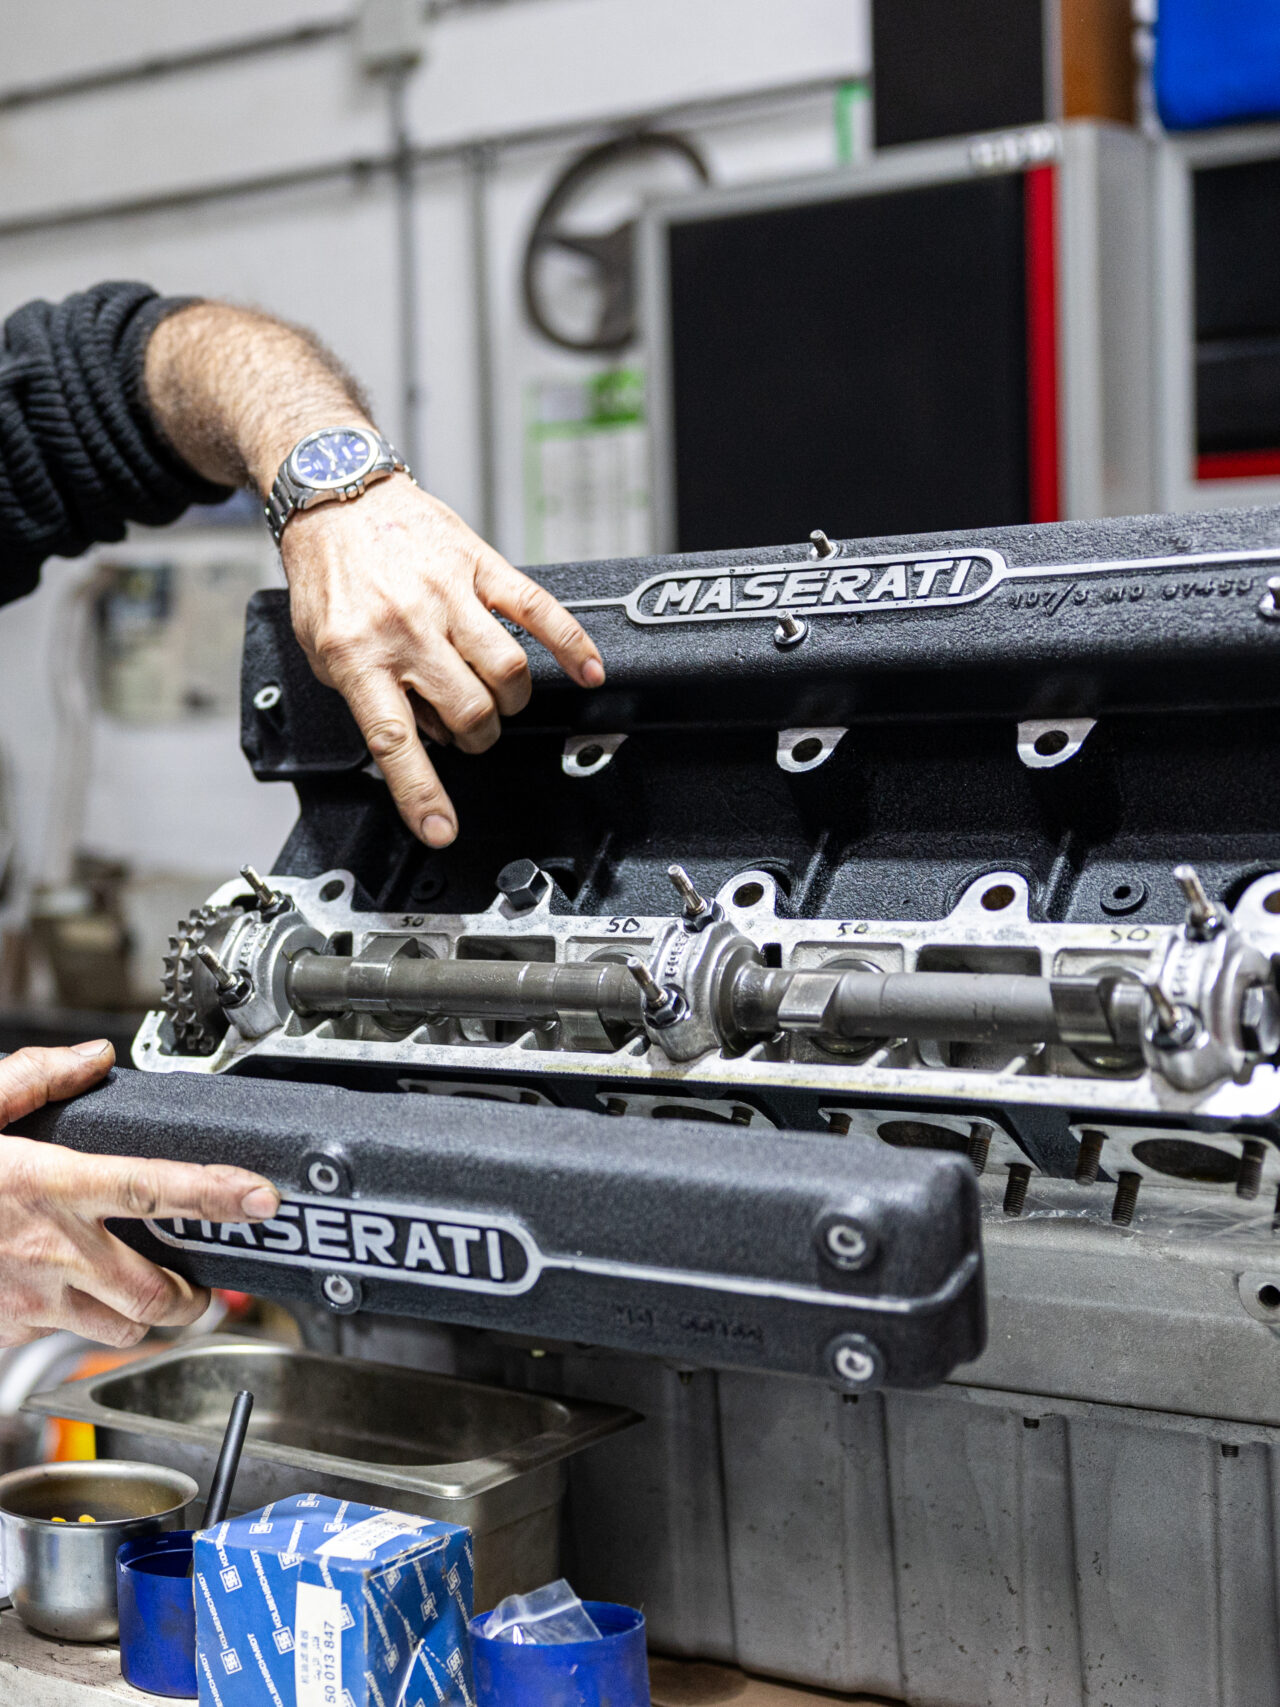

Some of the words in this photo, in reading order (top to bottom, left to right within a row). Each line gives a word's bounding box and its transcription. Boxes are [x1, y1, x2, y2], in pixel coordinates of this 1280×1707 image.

[652, 559, 972, 615] MASERATI
[606, 917, 641, 933] 50
[196, 1572, 229, 1650] KOLBENSCHMIDT
[250, 1549, 283, 1629] KOLBENSCHMIDT
[323, 1621, 336, 1649] 847
[199, 1653, 224, 1707] ENSCHMIDT
[247, 1633, 283, 1707] OLBENSCHMIDT
[324, 1654, 336, 1681] 013
[324, 1685, 336, 1704] 50
